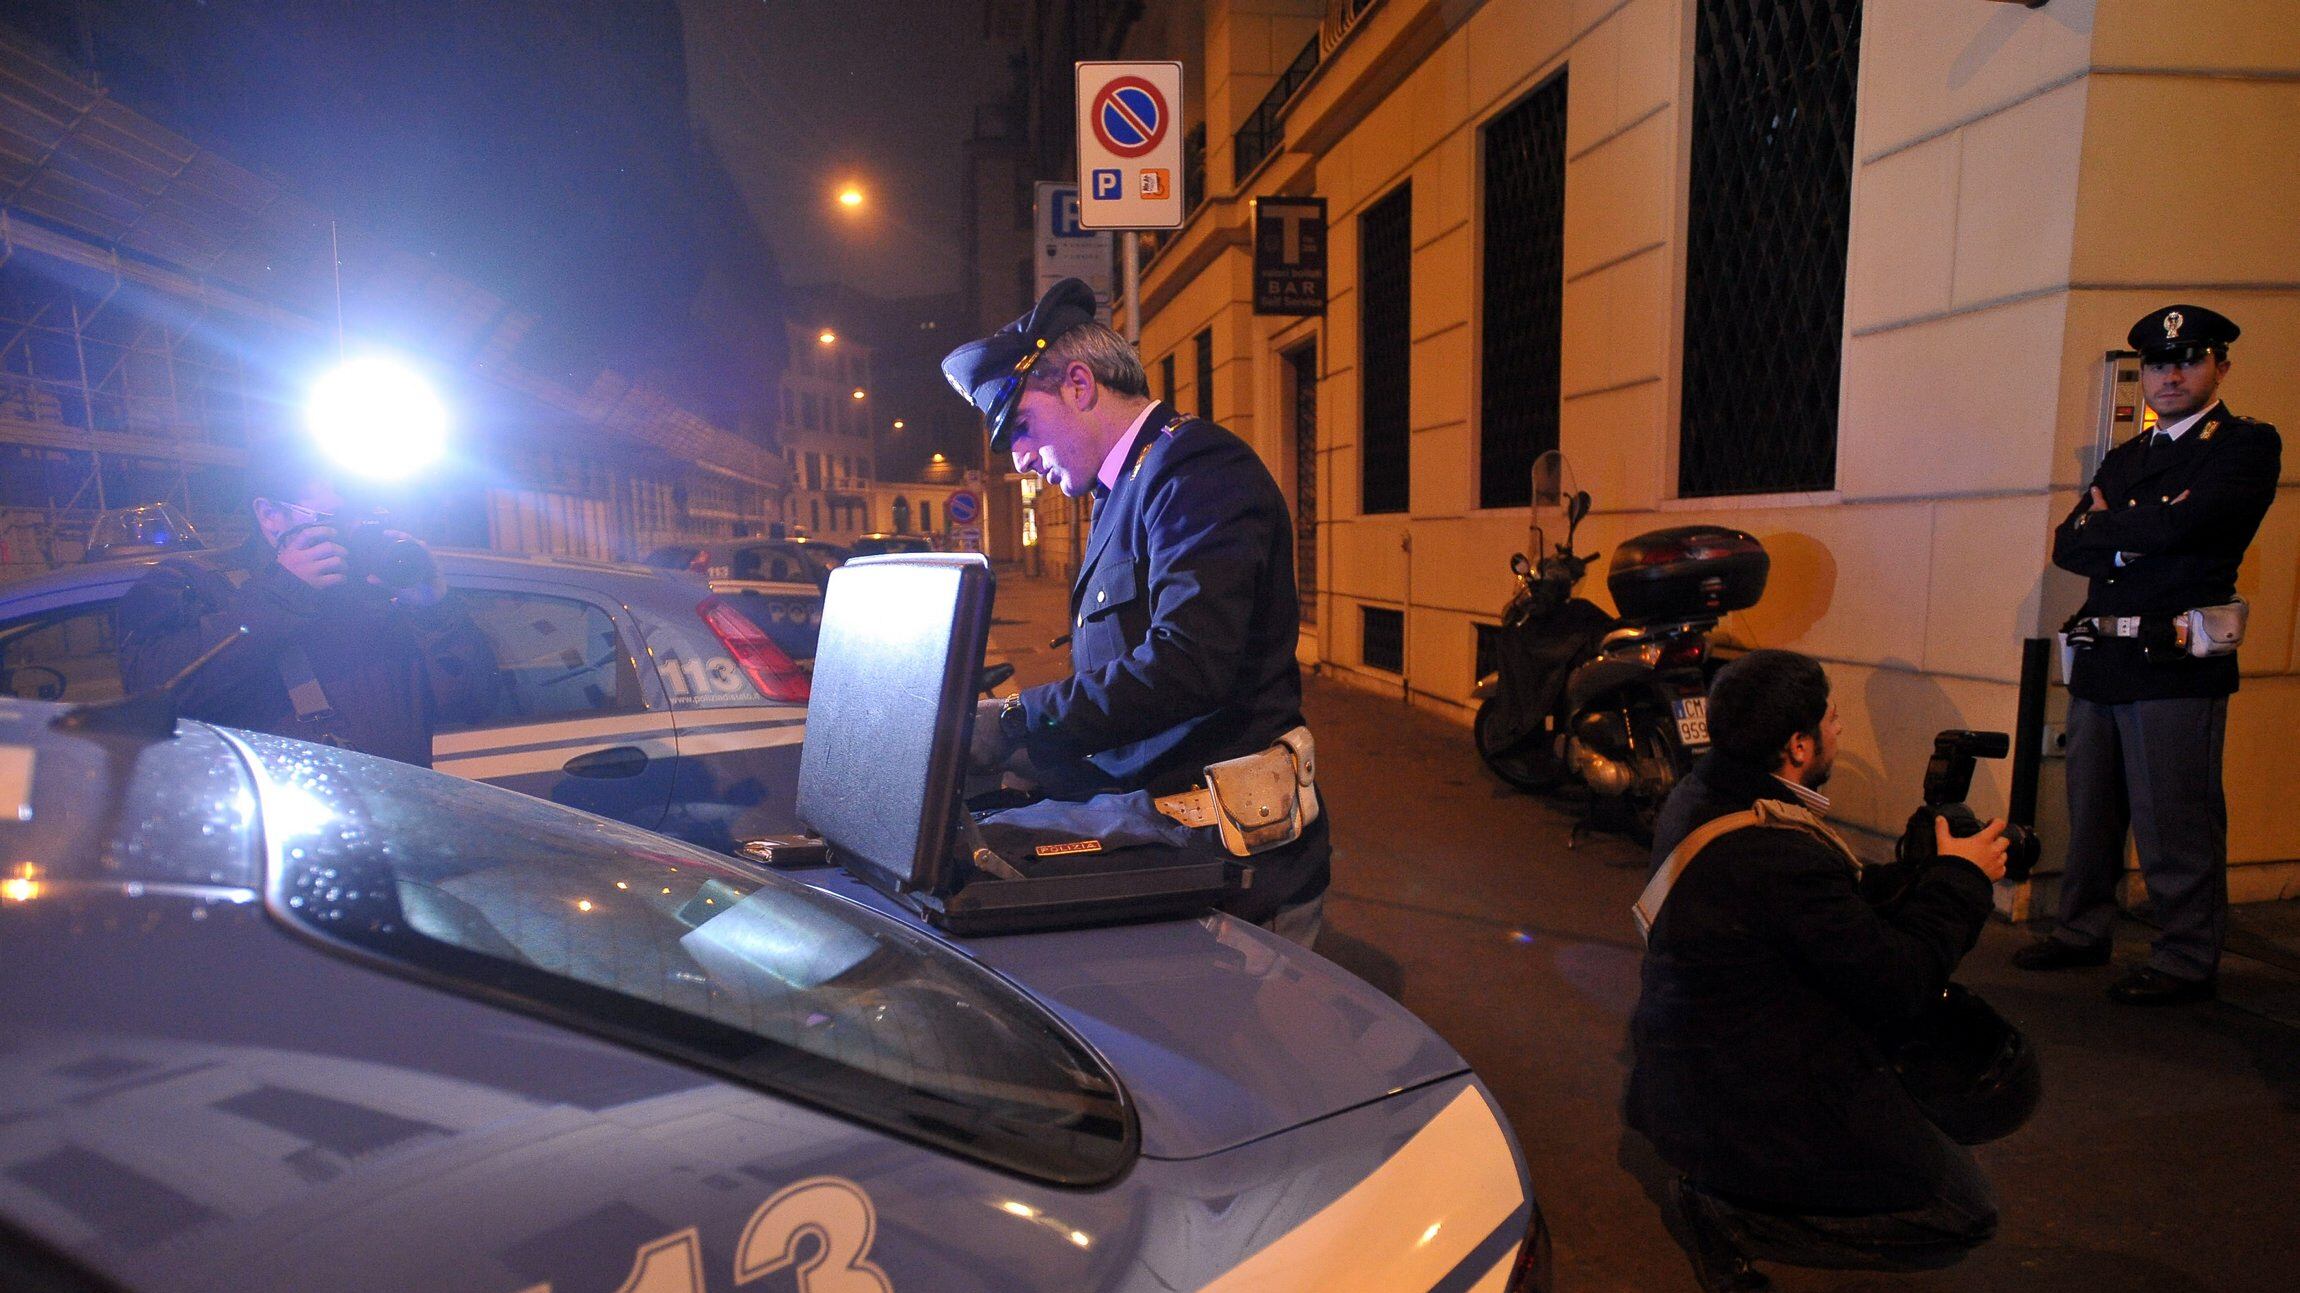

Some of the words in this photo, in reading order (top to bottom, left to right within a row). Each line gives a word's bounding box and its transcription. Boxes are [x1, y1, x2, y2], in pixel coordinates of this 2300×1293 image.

[1099, 173, 1116, 196] P
[1262, 205, 1319, 264] T
[1268, 281, 1314, 294] BAR
[707, 565, 729, 577] 113
[658, 656, 744, 695] 113
[1685, 699, 1705, 718] CM
[1681, 721, 1708, 740] 959
[1040, 842, 1097, 854] POLIZIA
